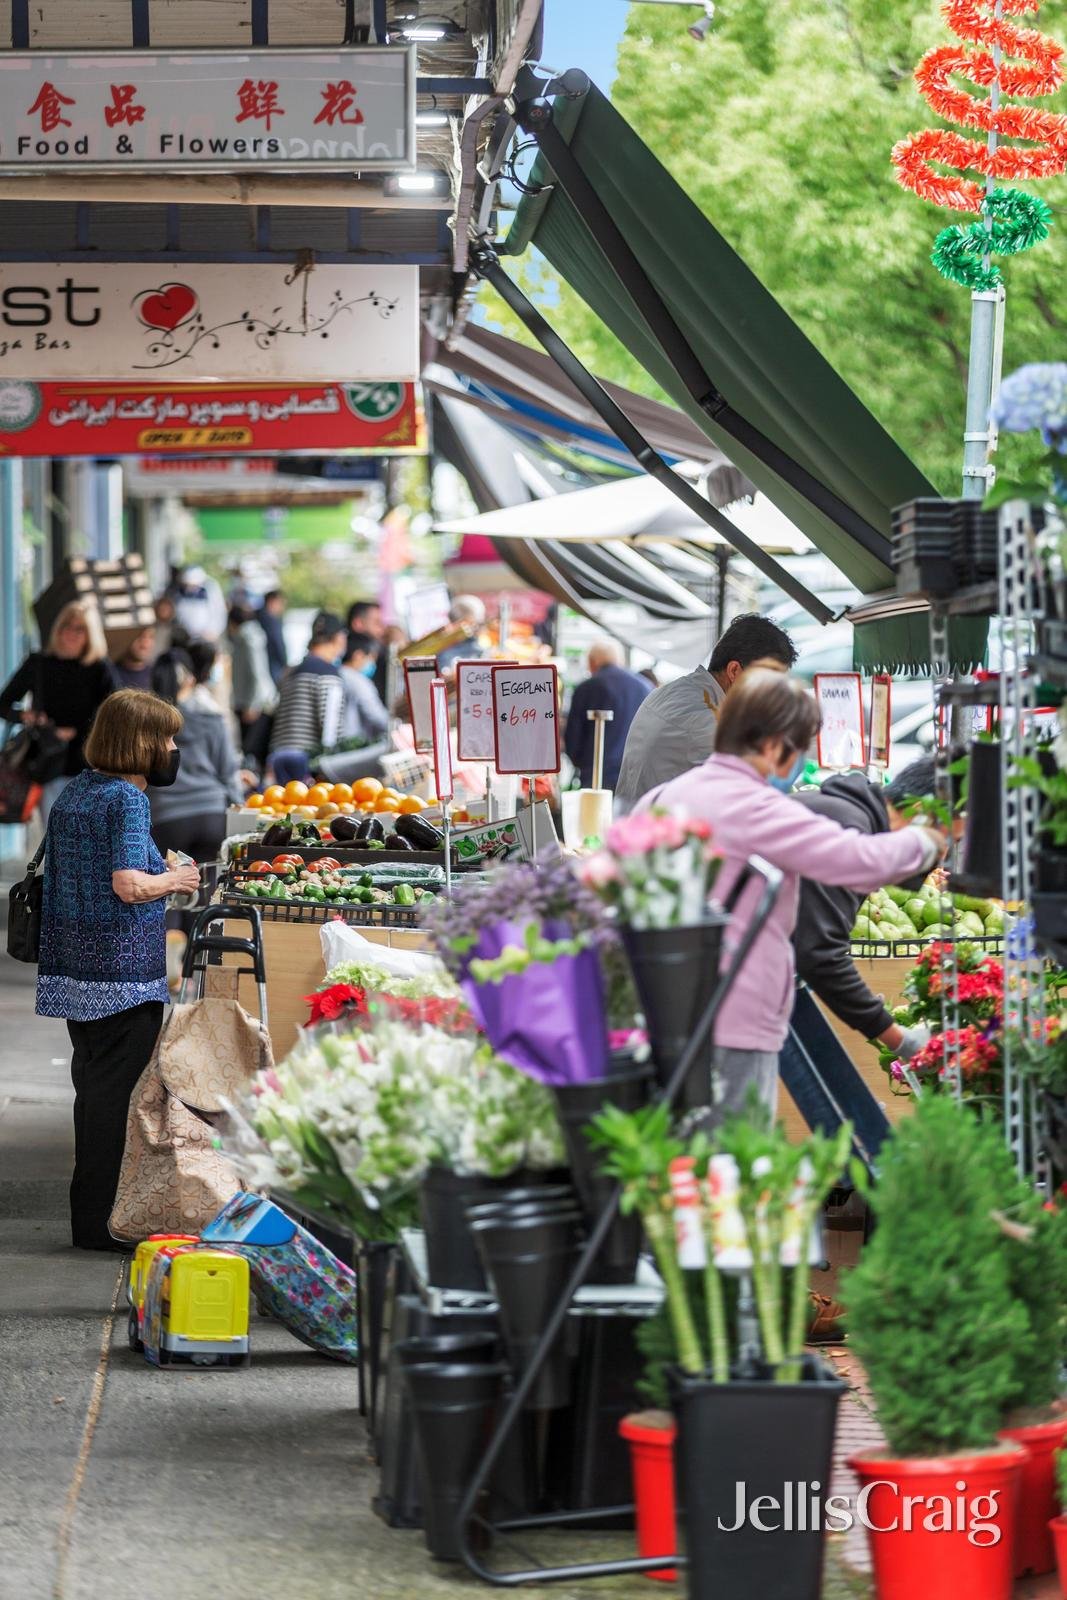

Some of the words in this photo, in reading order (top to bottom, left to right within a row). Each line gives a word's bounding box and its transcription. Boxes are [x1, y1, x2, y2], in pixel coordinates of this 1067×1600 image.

[27, 80, 147, 133] 食品
[17, 136, 89, 155] Food
[116, 135, 134, 154] &
[160, 134, 280, 154] Flowers
[2, 278, 101, 327] st
[501, 681, 552, 697] EGGPLANT
